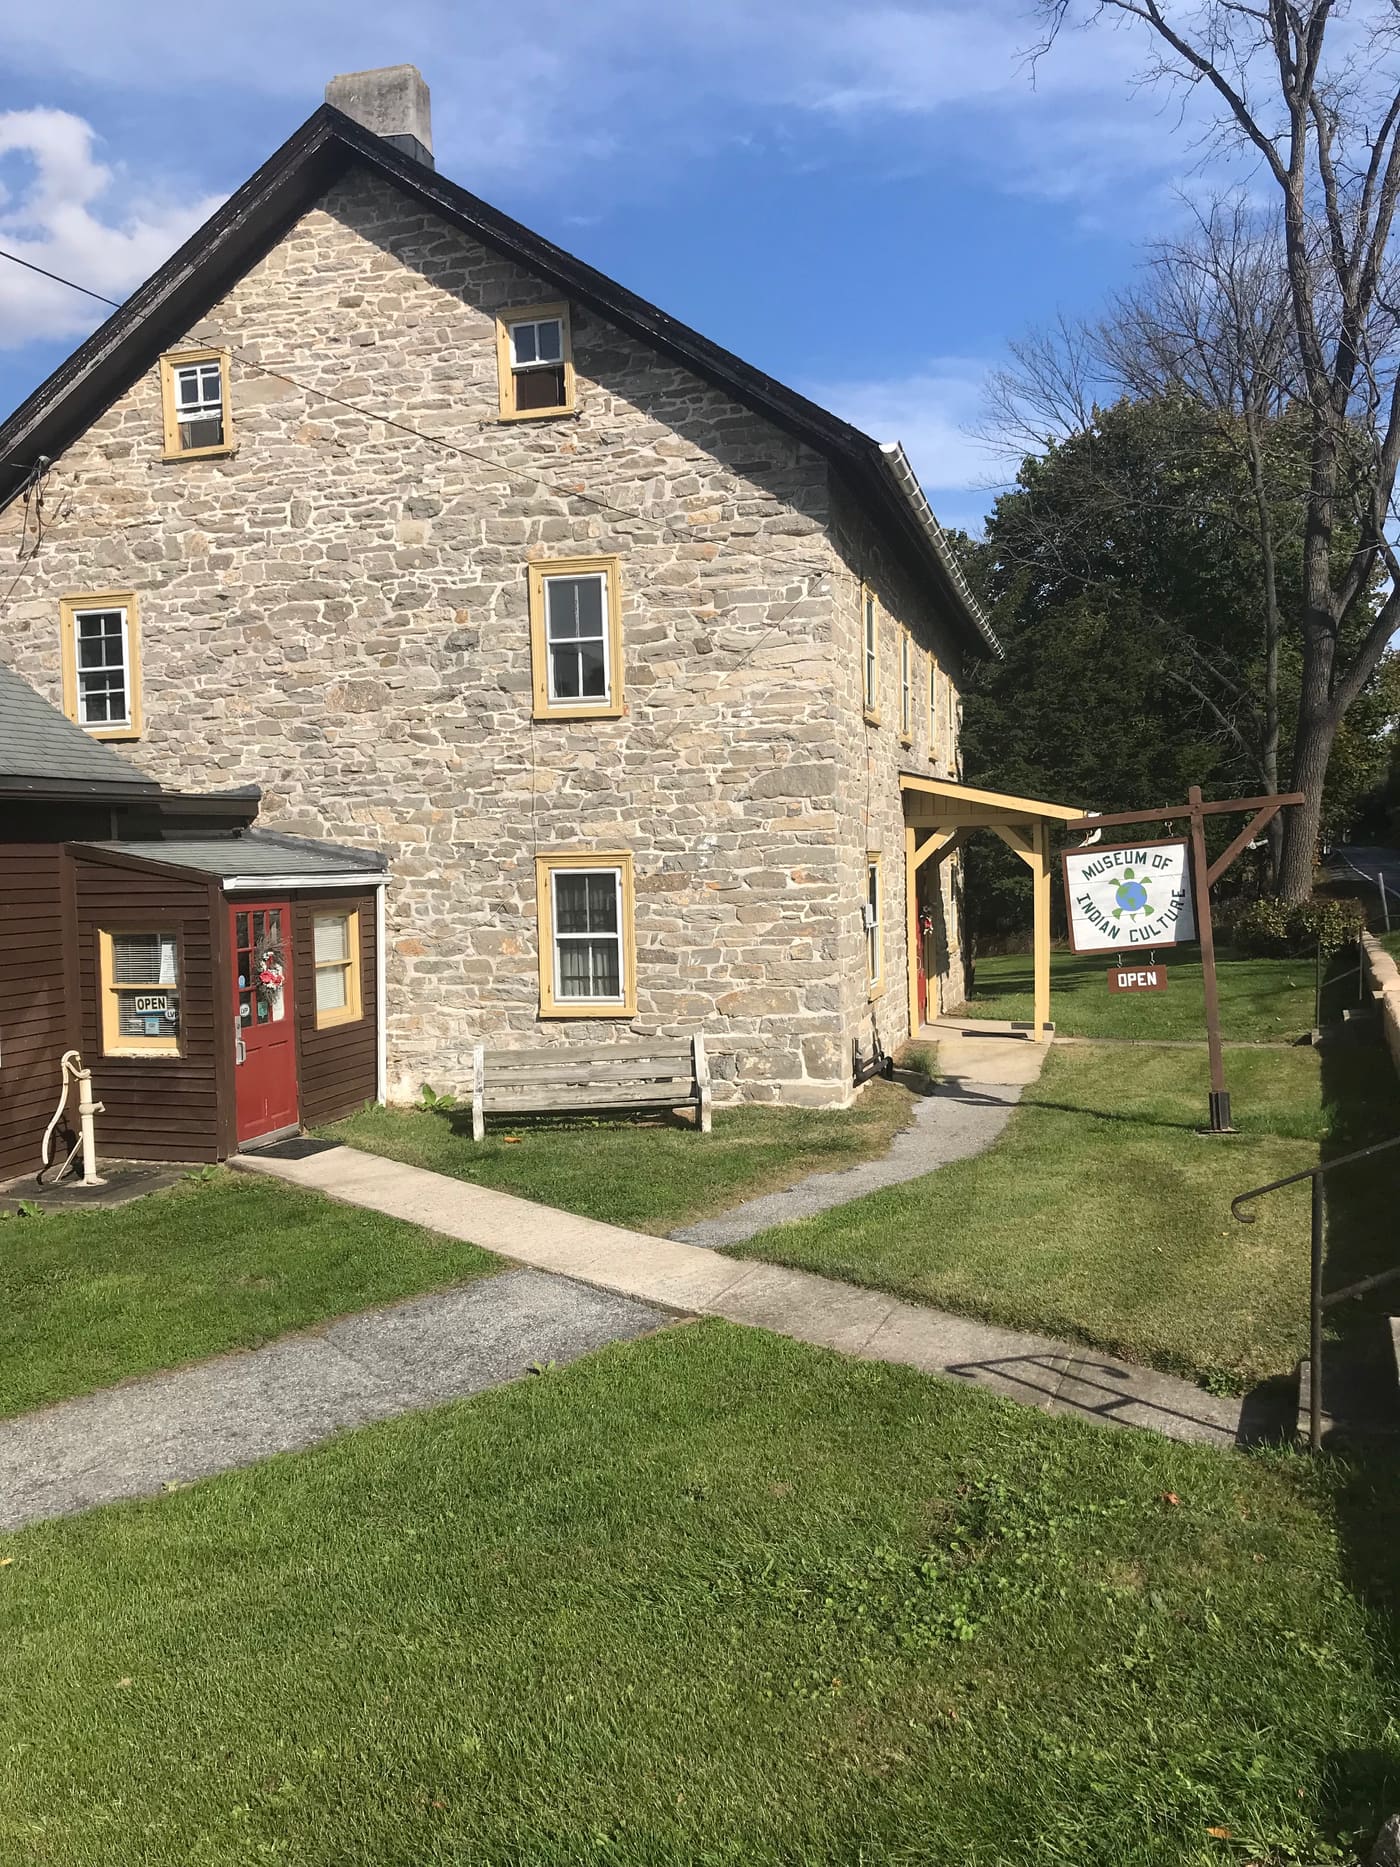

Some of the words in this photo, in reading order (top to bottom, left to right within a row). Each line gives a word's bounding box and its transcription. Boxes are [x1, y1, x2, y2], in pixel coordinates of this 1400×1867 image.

[1081, 851, 1148, 881] MUSEUM
[1151, 854, 1173, 870] OF
[1076, 892, 1121, 940] INDIAN
[1129, 888, 1186, 943] CULTURE
[1117, 971, 1157, 988] OPEN
[137, 997, 165, 1010] OPEN
